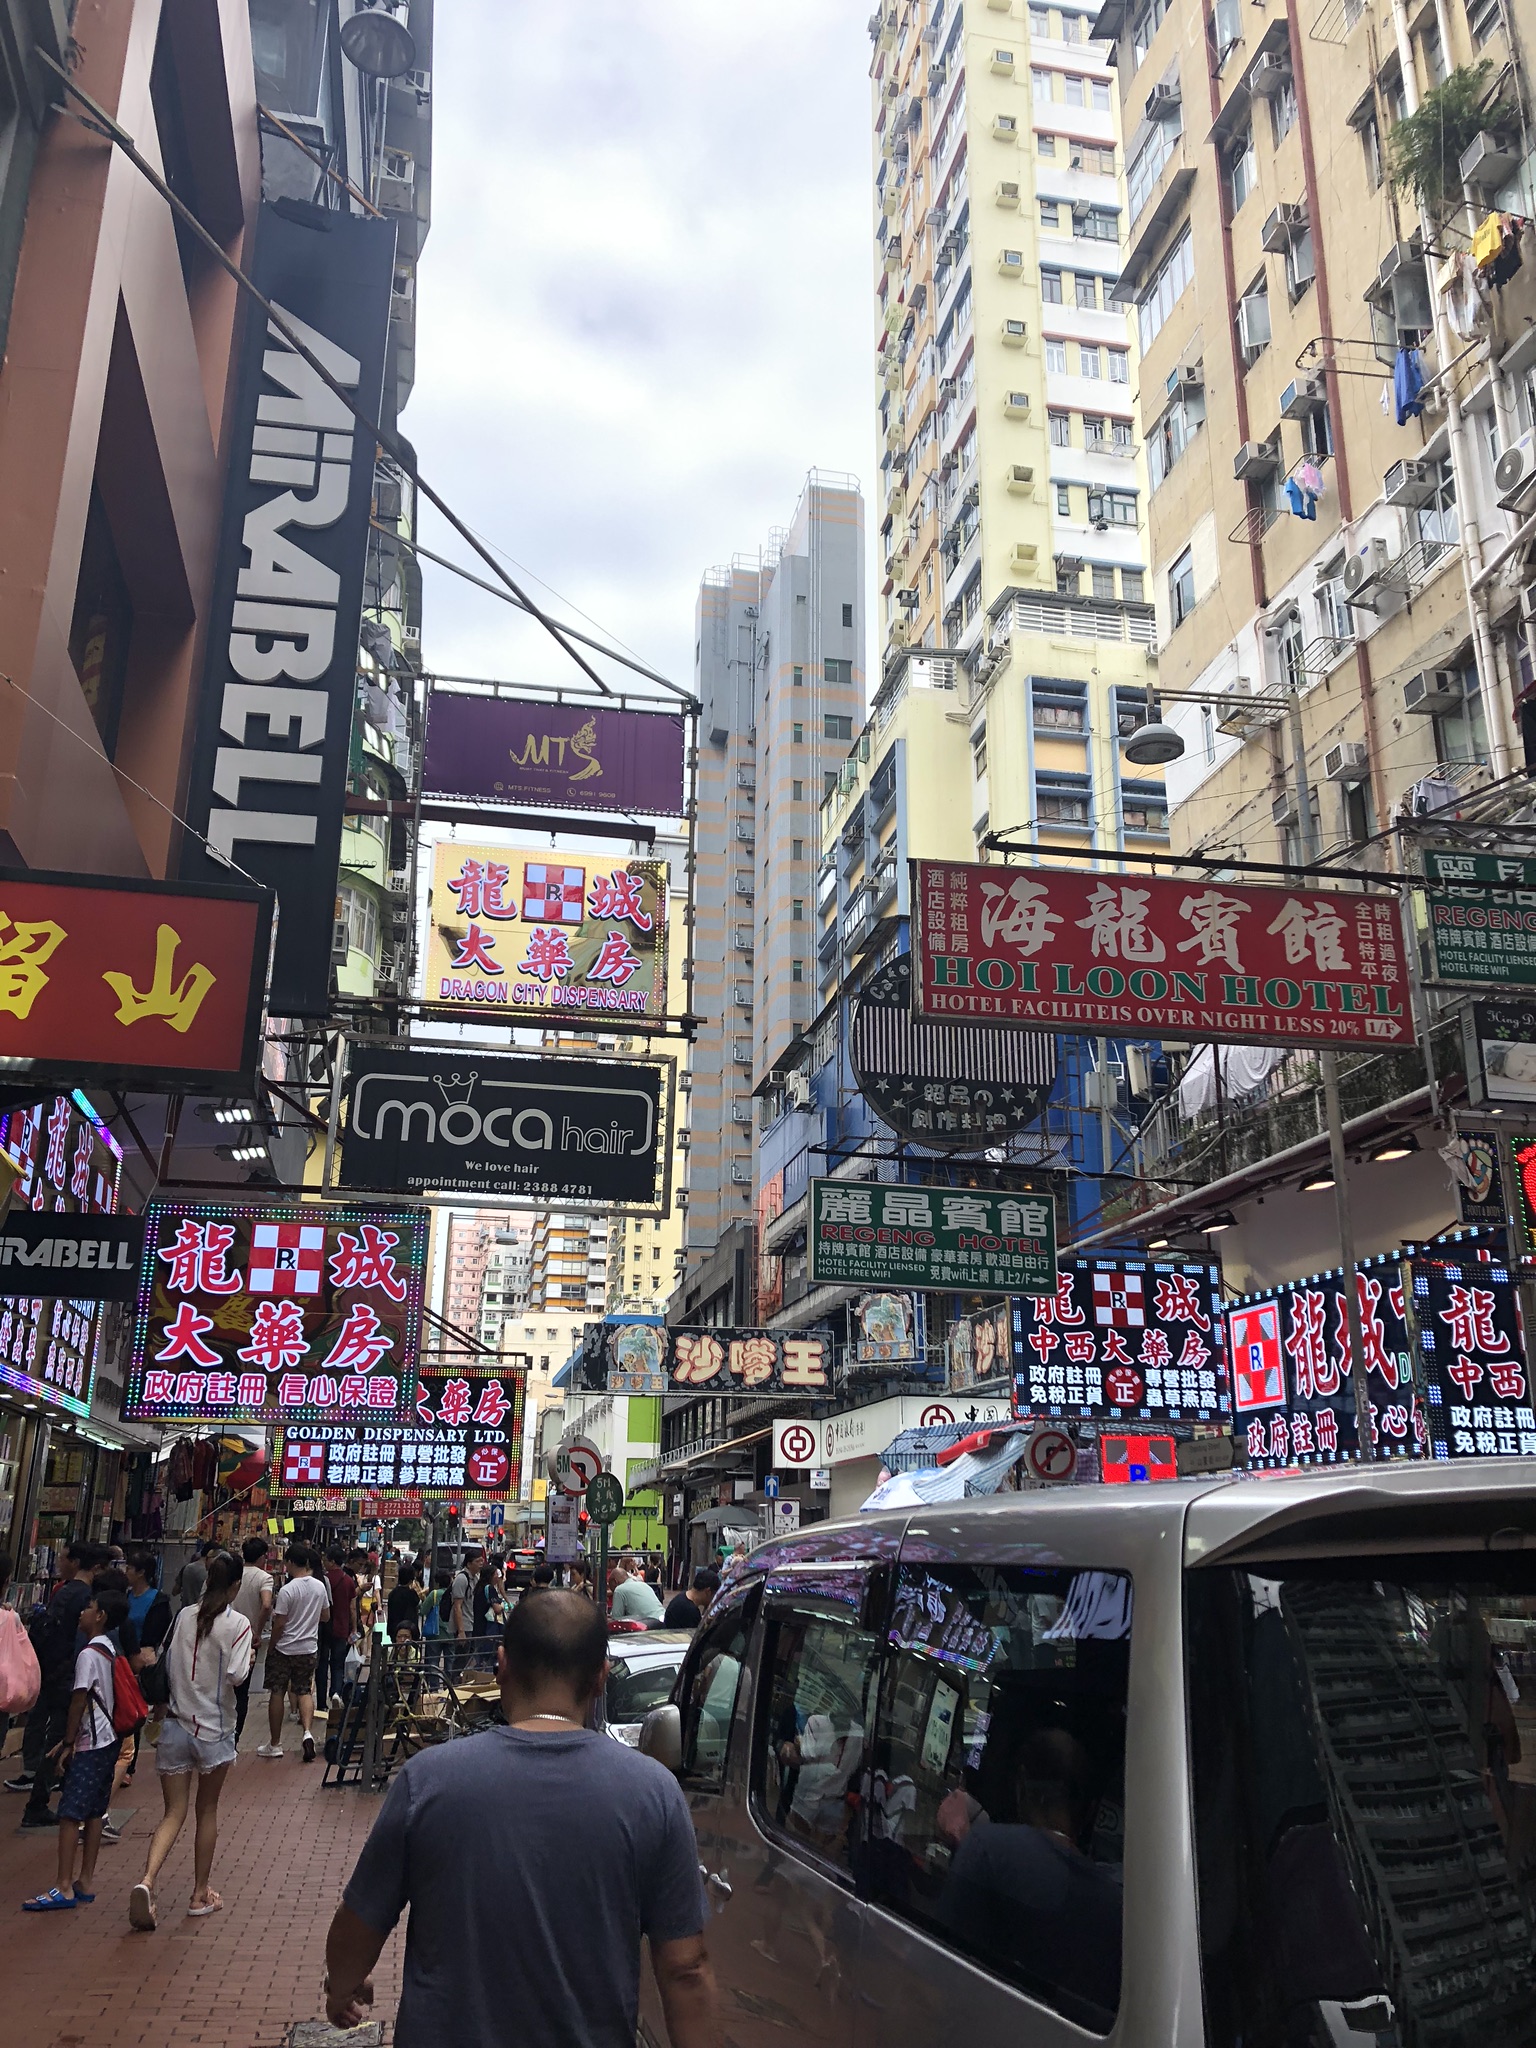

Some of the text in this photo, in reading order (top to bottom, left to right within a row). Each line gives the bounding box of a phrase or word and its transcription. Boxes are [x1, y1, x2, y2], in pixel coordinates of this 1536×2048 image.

[206, 298, 362, 868] MIRABELL
[509, 715, 603, 780] MTS
[448, 858, 517, 920] 龍
[588, 869, 652, 932] 城
[927, 868, 946, 952] 酒店設備
[950, 871, 968, 953] 純粹租房
[980, 875, 1353, 974] 海龍賓館
[1354, 901, 1378, 980] 全日特平
[1374, 903, 1399, 982] 時租過夜
[1436, 928, 1487, 949] 持牌賓館
[451, 923, 642, 987] 大藥房
[1439, 950, 1468, 961] HOTEL
[1468, 952, 1504, 964] FACILITY
[1440, 963, 1509, 976] HOTEL FREE WIFI
[440, 976, 649, 1012] DRAGON CITY DISPENSARY
[930, 954, 1403, 1017] HOI LOON HOTEL
[931, 993, 1396, 1037] HOTEL FACILITEIS OVER NIGHT LESS 20% 1/F
[375, 1100, 634, 1155] moca hair
[407, 1174, 593, 1195] appointment call: 2388 4781
[465, 1160, 540, 1175] We love hair
[818, 1187, 1049, 1238] 麗晶賓館
[818, 1241, 1050, 1271] 持牌賓館 酒店設備 豪華套房 歡迎自由行
[820, 1224, 1048, 1255] REGENG HOTEL
[160, 1218, 244, 1294] 龍
[328, 1223, 408, 1302] 城
[818, 1257, 926, 1272] HOTEL FACILITY LIENSED
[818, 1266, 891, 1278] HOTEL FREE WIFI
[1153, 1273, 1212, 1333] 城
[1439, 1284, 1511, 1354] 龍
[155, 1300, 395, 1375] 大藥房
[1028, 1325, 1212, 1370] 中西大藥房
[142, 1370, 399, 1409] 政府註冊 信心保證
[1029, 1365, 1103, 1385] 政府註冊
[1144, 1368, 1217, 1390] 專營批發
[1029, 1385, 1104, 1407] 免稅正貨
[1115, 1382, 1135, 1403] 正
[1447, 1355, 1526, 1401] 中西
[287, 1426, 510, 1444] GOLDEN DISPENSARY LTD.
[1247, 1407, 1338, 1459] 政府註冊
[1450, 1405, 1536, 1429] 政府註冊
[328, 1443, 396, 1463] 政府註冊
[400, 1444, 467, 1465] 專營批發
[477, 1461, 498, 1482] 正
[327, 1465, 466, 1486] 老牌正藥 參茸燕窩
[596, 1477, 611, 1489] 5M
[384, 1508, 400, 1516] 2771
[402, 1508, 420, 1516] 1210
